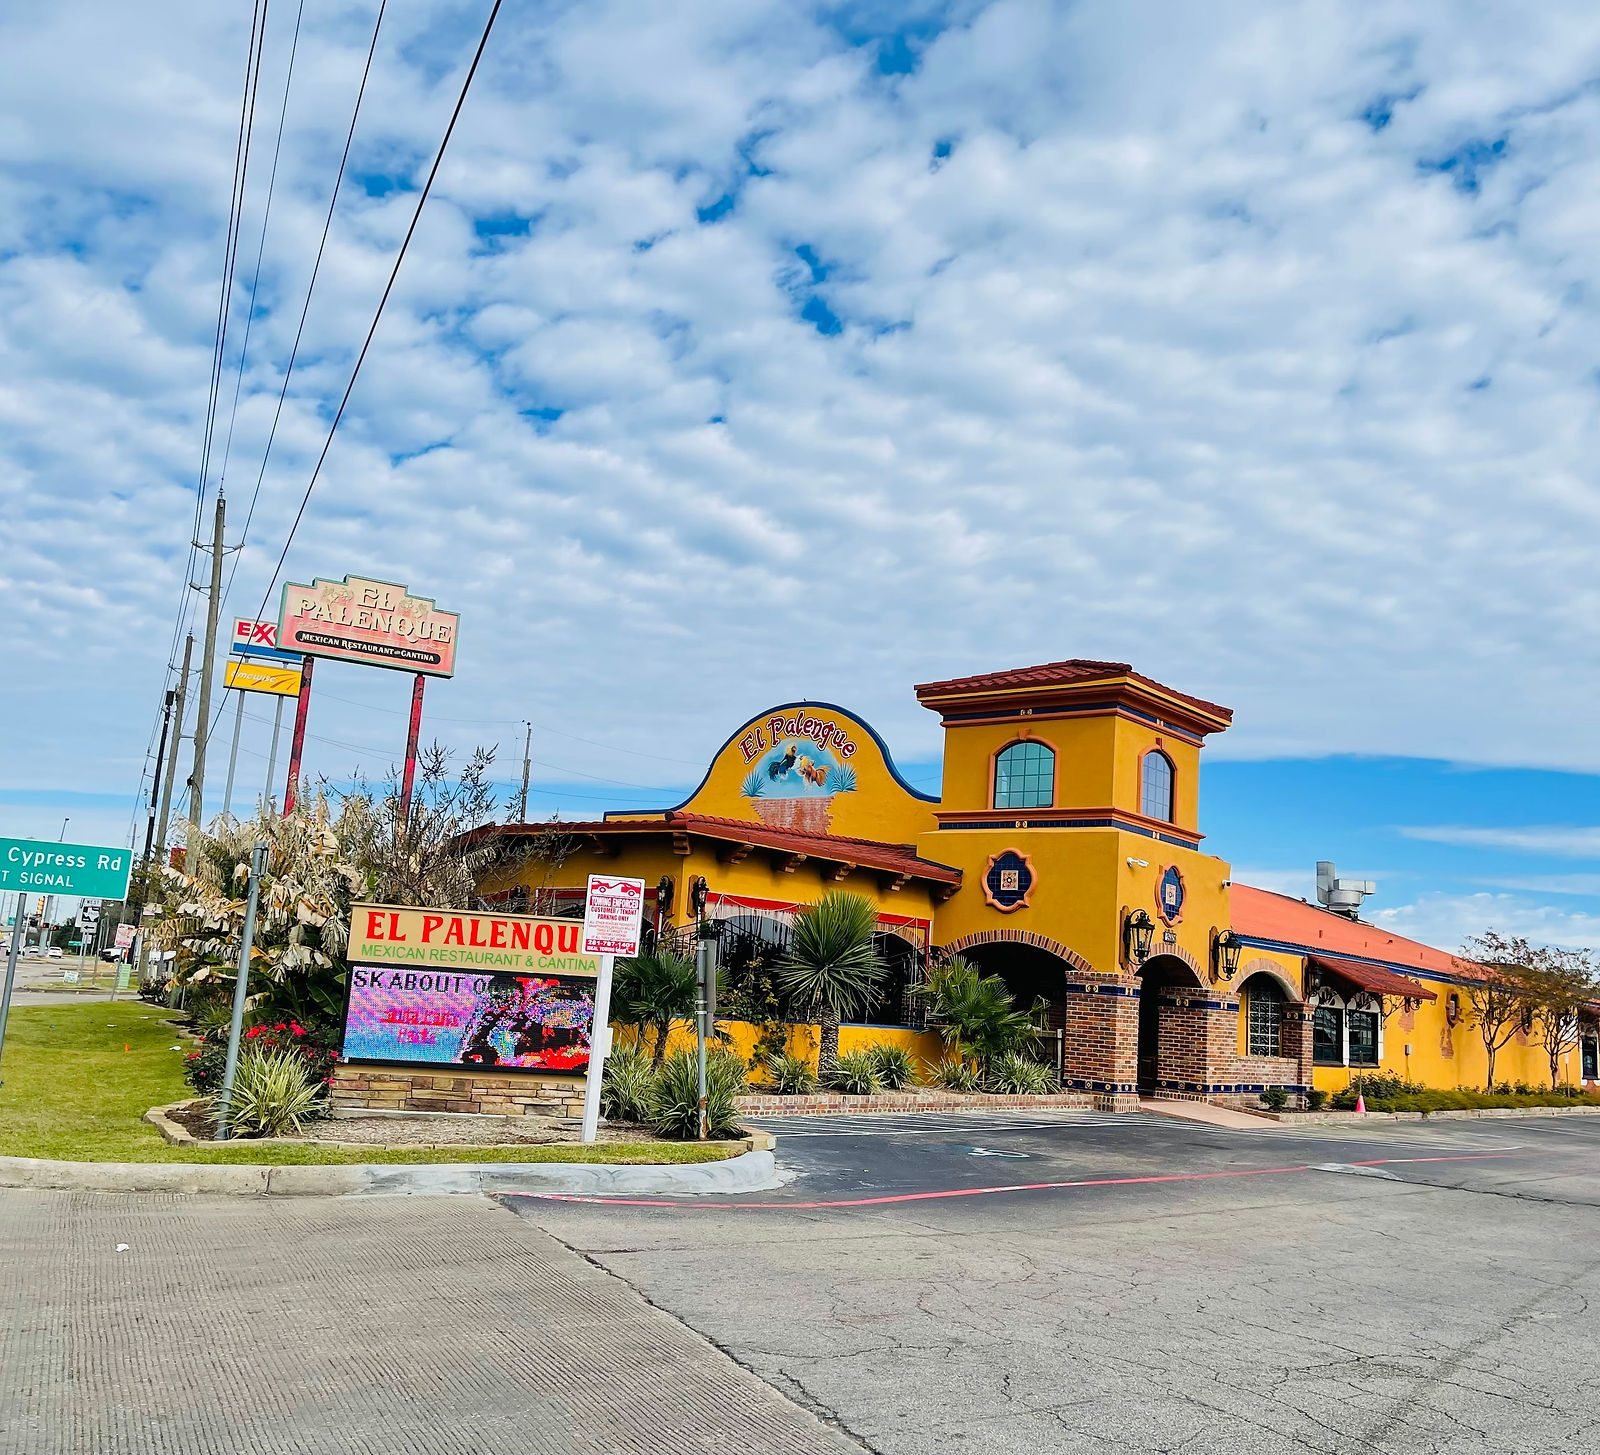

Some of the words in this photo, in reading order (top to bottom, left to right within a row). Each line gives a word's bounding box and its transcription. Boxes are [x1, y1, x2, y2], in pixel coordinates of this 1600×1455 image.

[357, 587, 397, 612] EL
[291, 597, 452, 644] PALENQUE
[237, 622, 277, 646] EXX
[300, 633, 340, 646] MEXICAN
[341, 641, 395, 656] RESTAURANT
[401, 649, 435, 662] CANTINA
[739, 728, 766, 764] El
[8, 847, 86, 868] Cypress
[97, 855, 122, 871] Rd
[0, 870, 10, 882] T
[19, 872, 74, 888] SIGNAL
[366, 911, 406, 942] EL
[422, 915, 579, 955] PALENQU
[361, 944, 426, 961] MEXICAN
[429, 949, 523, 966] RESTAURANT
[525, 954, 534, 967] &
[538, 956, 597, 971] CANTINA
[388, 972, 466, 994] ABOUT
[473, 978, 487, 994] O
